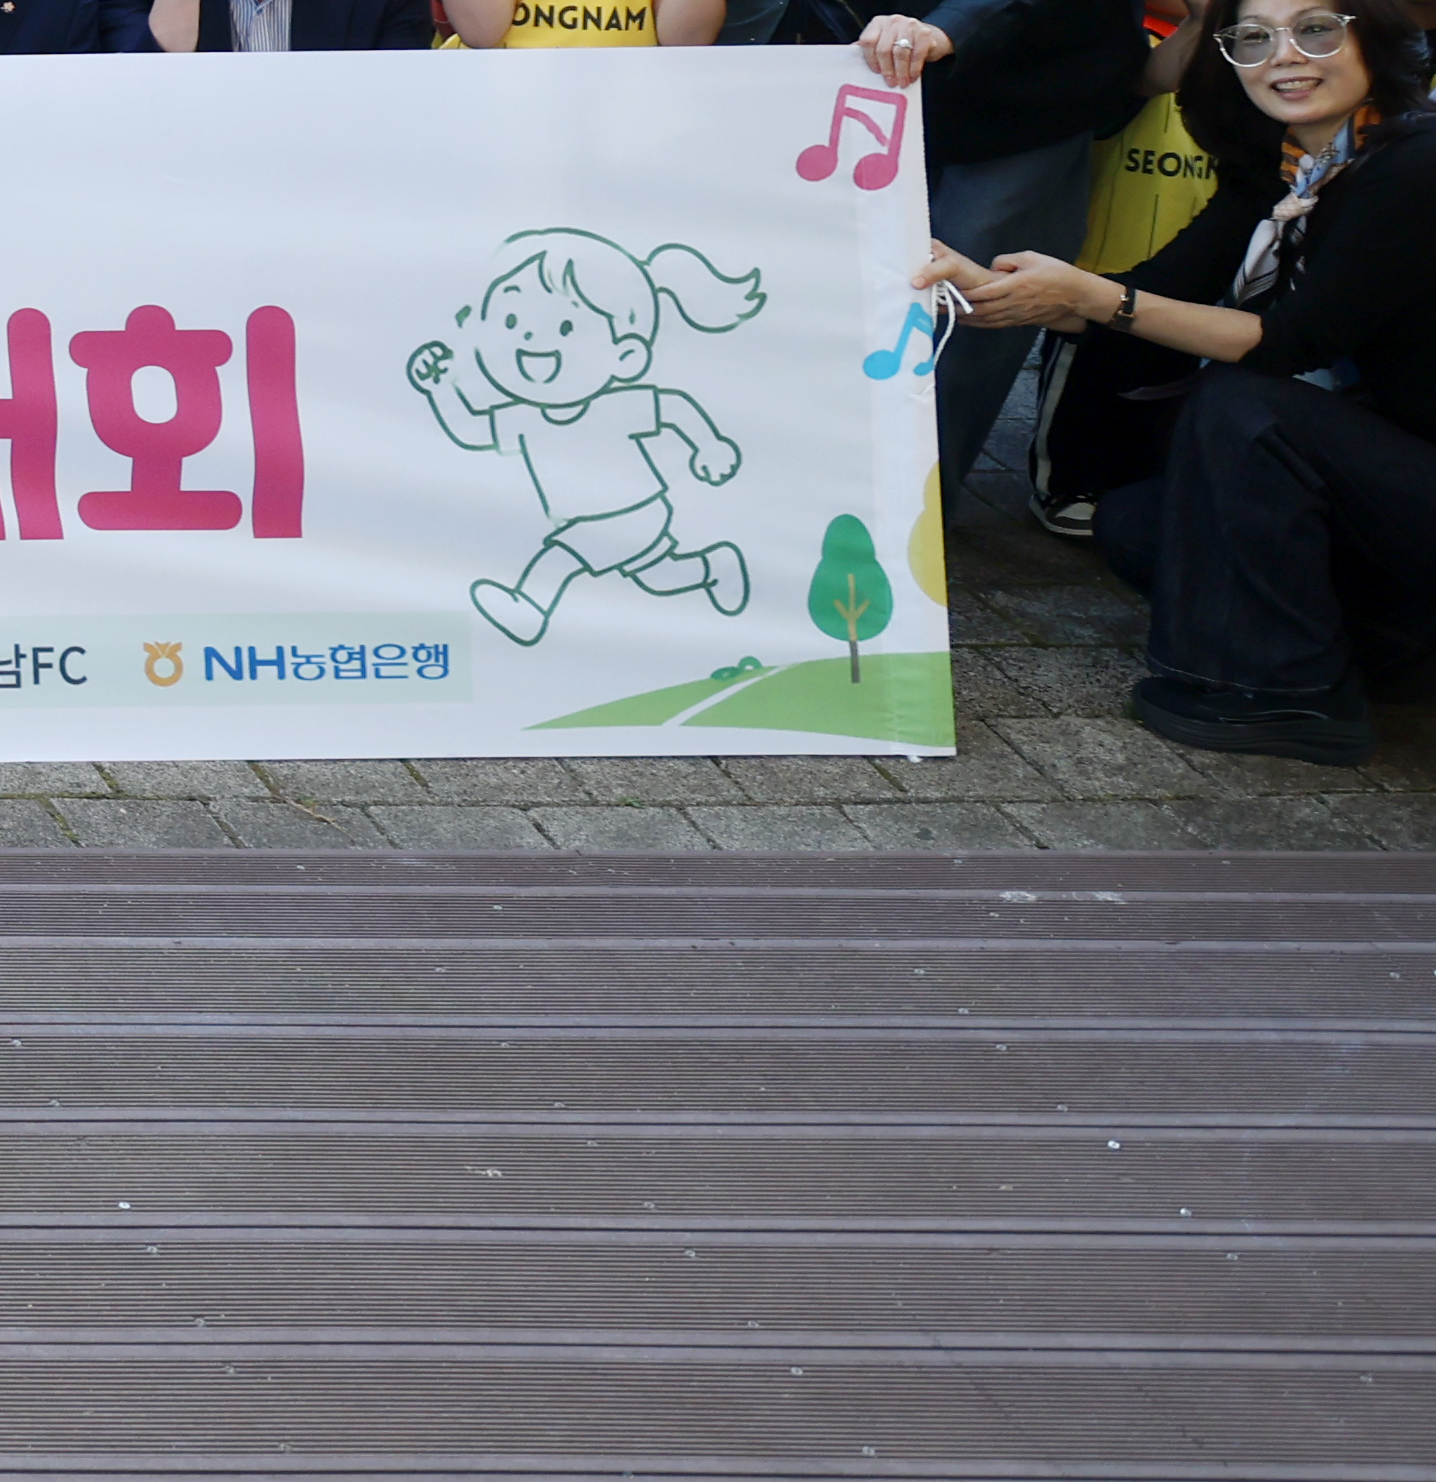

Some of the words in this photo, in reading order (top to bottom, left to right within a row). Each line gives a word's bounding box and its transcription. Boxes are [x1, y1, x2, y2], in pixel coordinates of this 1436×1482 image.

[511, 4, 646, 32] ONGNAM
[1125, 147, 1220, 178] SEONGN
[204, 642, 450, 682] NH농협은행
